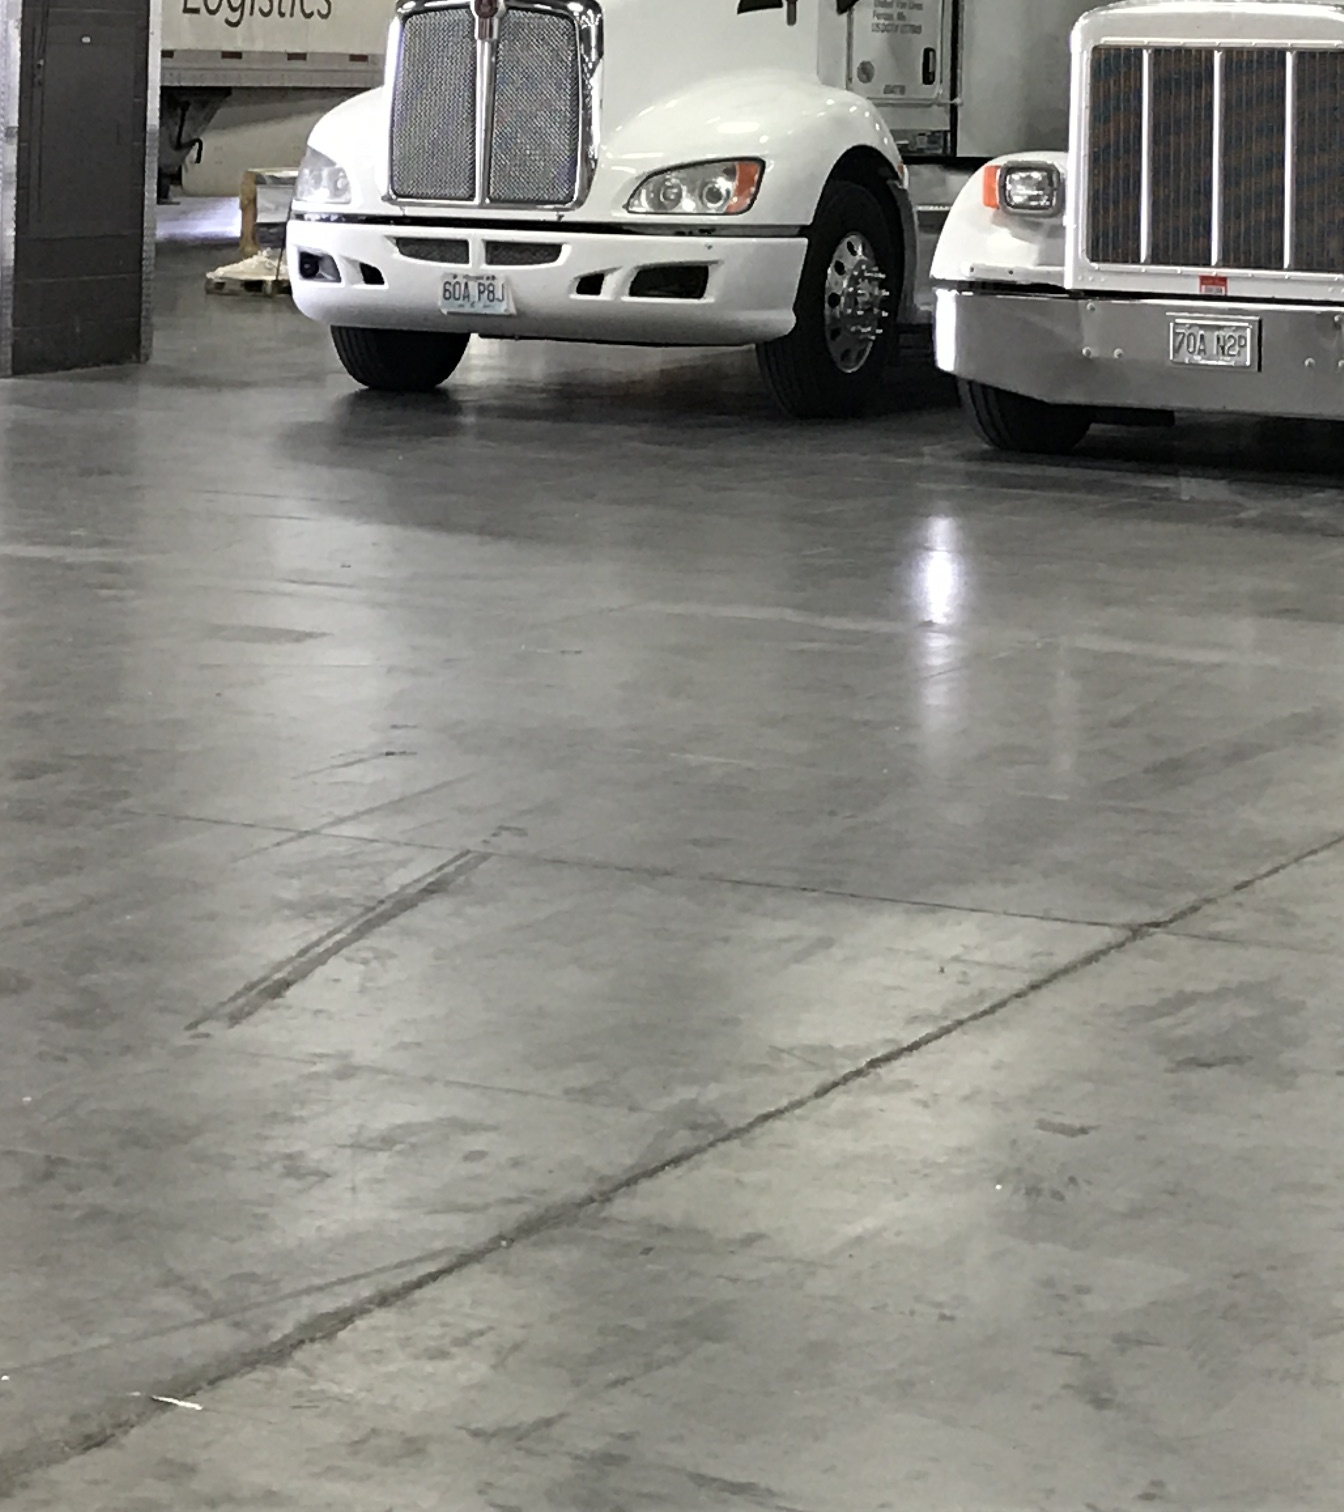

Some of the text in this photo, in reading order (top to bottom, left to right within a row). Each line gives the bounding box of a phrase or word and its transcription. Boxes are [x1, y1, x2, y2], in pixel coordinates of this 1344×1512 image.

[442, 280, 505, 303] 60A P8J
[1174, 329, 1248, 358] 70A N2P
